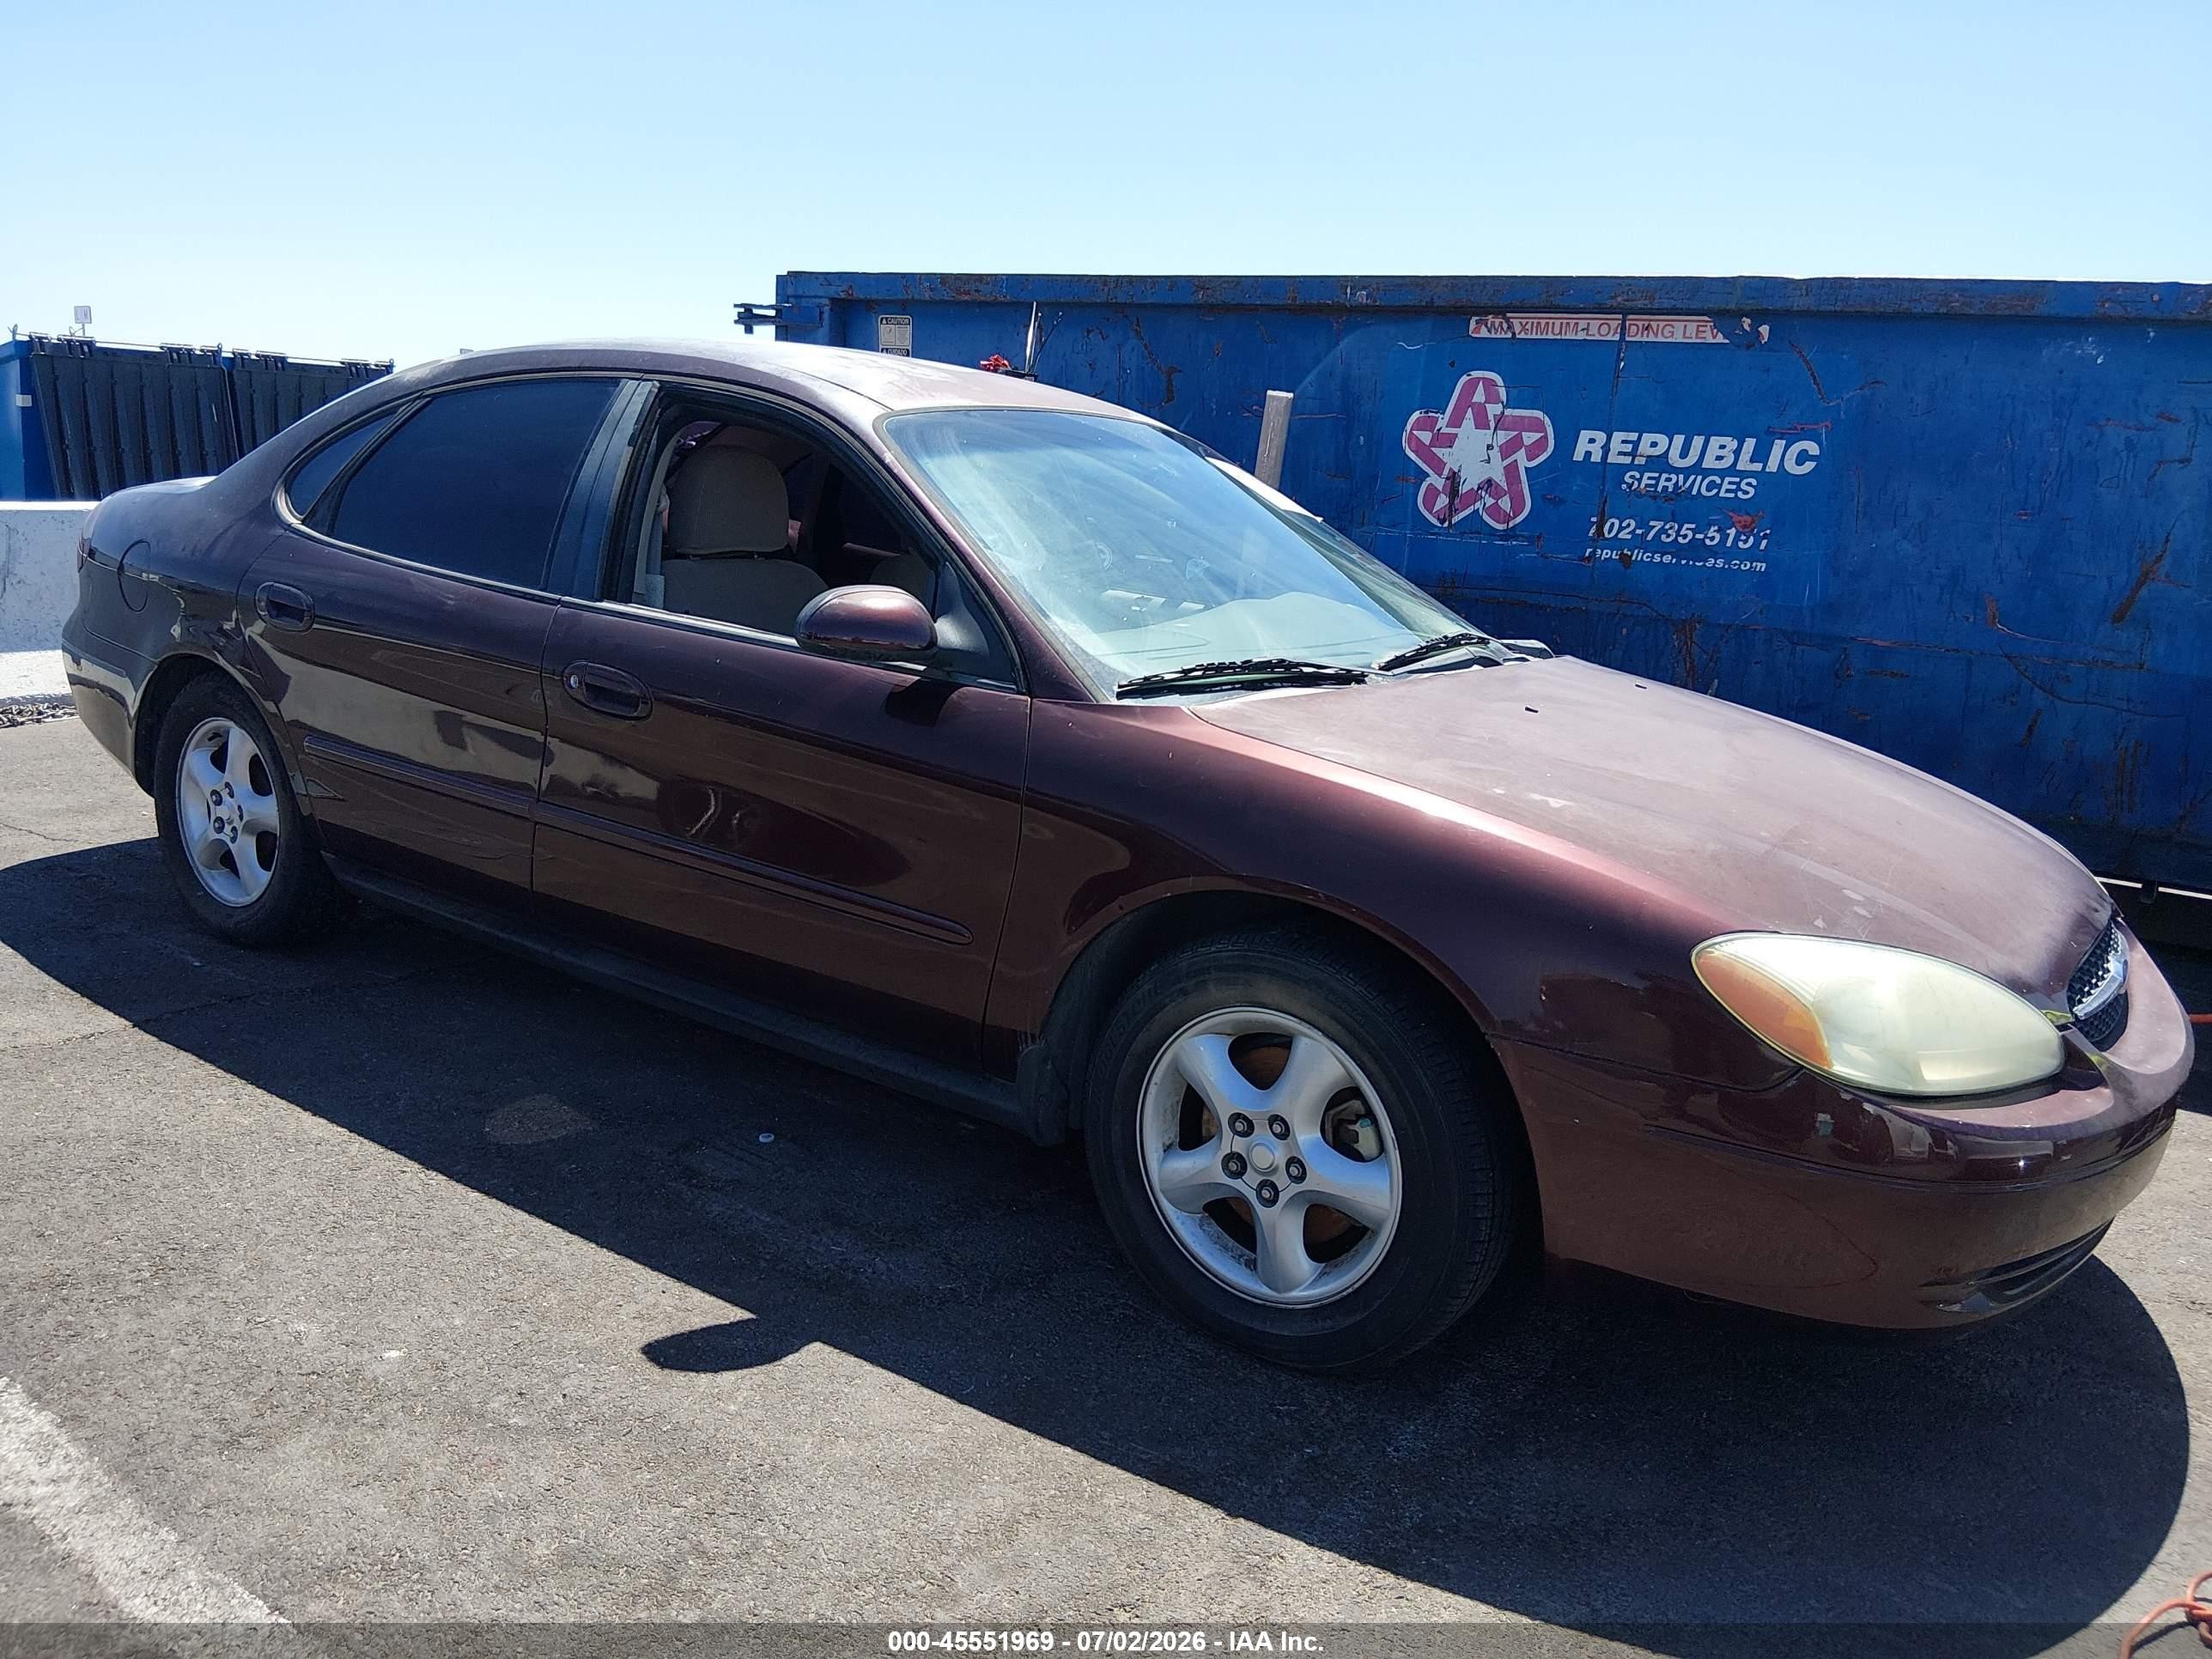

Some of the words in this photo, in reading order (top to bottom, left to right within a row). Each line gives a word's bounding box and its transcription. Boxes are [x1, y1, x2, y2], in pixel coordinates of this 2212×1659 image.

[1487, 319, 1580, 337] MAXIMUM
[1585, 321, 1675, 339] LOADING
[1682, 323, 1723, 341] LEV
[1572, 429, 1820, 476] REPUBLIC
[1621, 470, 1758, 500] SERVICES
